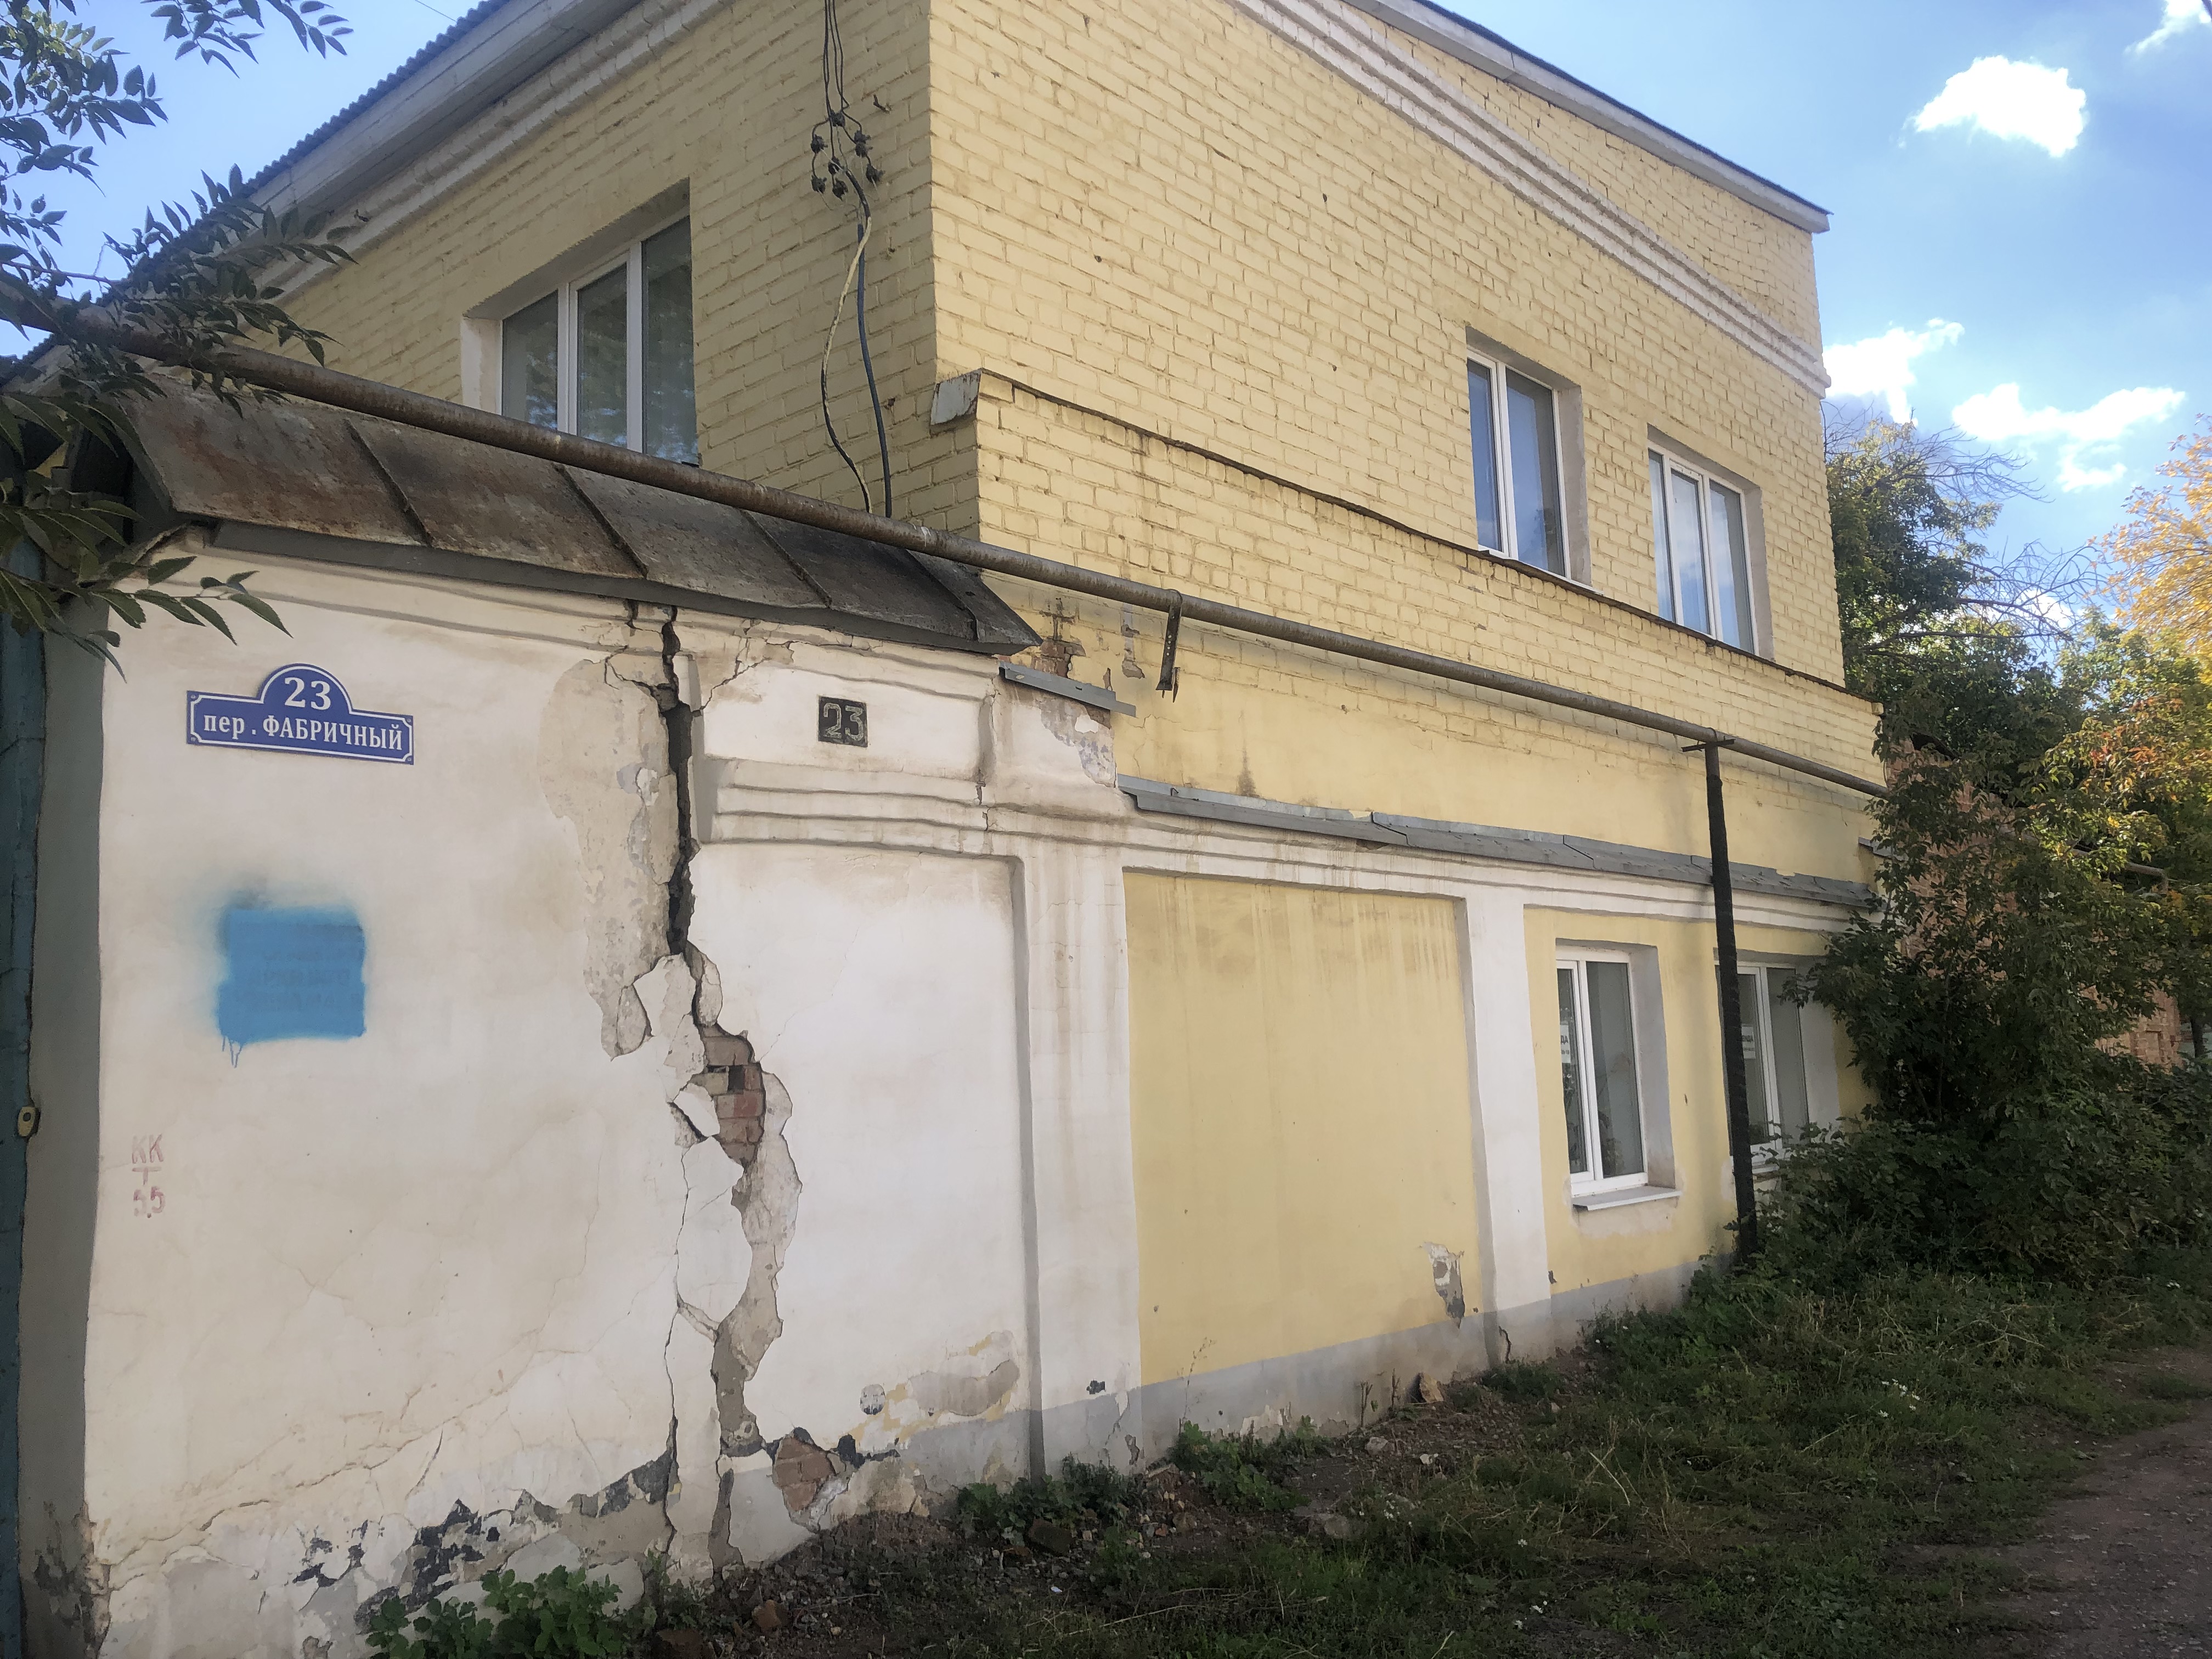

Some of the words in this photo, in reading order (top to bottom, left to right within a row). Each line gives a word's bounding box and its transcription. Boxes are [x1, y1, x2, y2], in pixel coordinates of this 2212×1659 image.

[284, 677, 331, 710] 23
[263, 715, 403, 751] ФАБРИЧНЫЙ
[823, 703, 864, 741] 23
